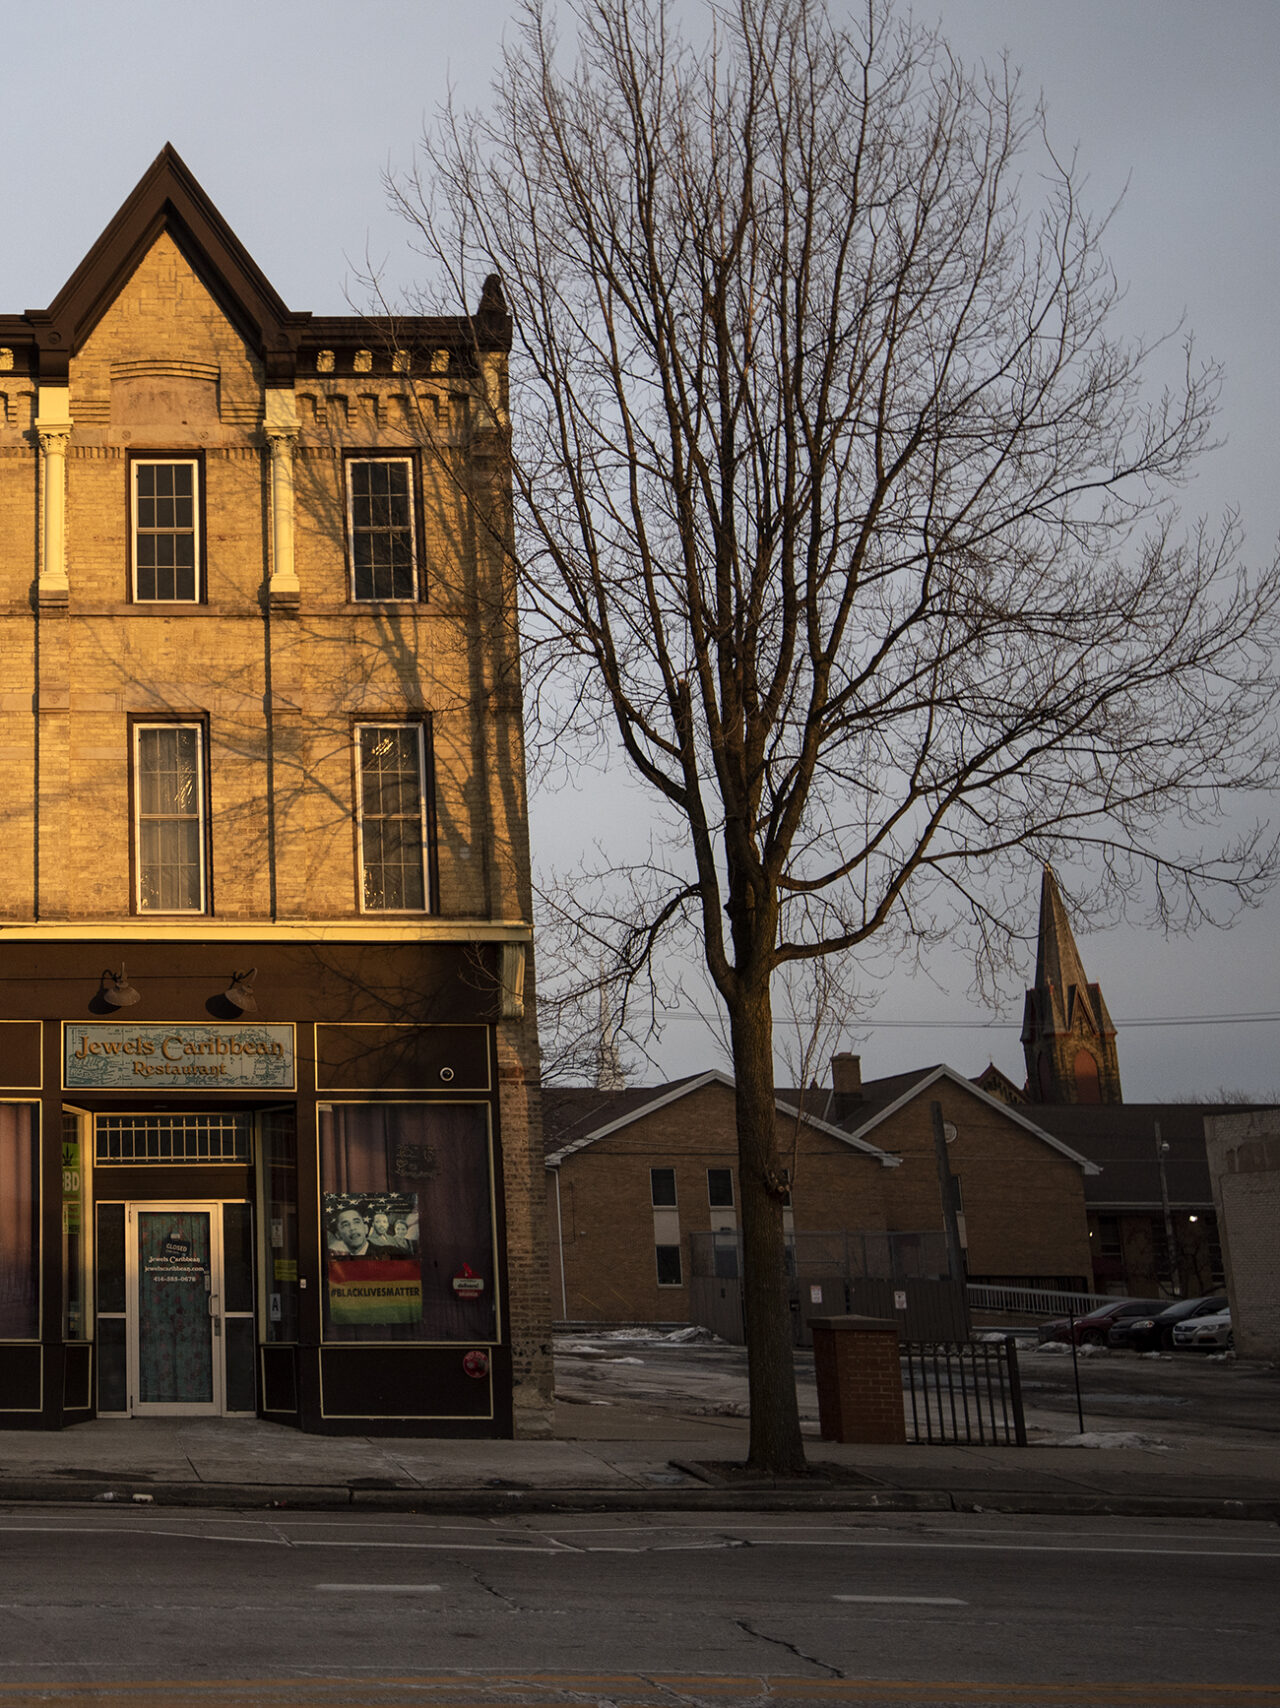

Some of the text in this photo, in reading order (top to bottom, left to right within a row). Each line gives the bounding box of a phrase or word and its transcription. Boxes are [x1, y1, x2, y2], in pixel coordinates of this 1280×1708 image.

[75, 1035, 155, 1060] Jewels
[161, 1035, 285, 1061] Caribbean
[132, 1061, 227, 1078] Restaurant
[62, 1171, 80, 1192] BD
[165, 1243, 188, 1253] CLOSED
[169, 1255, 201, 1264] Caribbean
[331, 1287, 420, 1297] #BLACKLIVESMATTER
[271, 1296, 280, 1312] A
